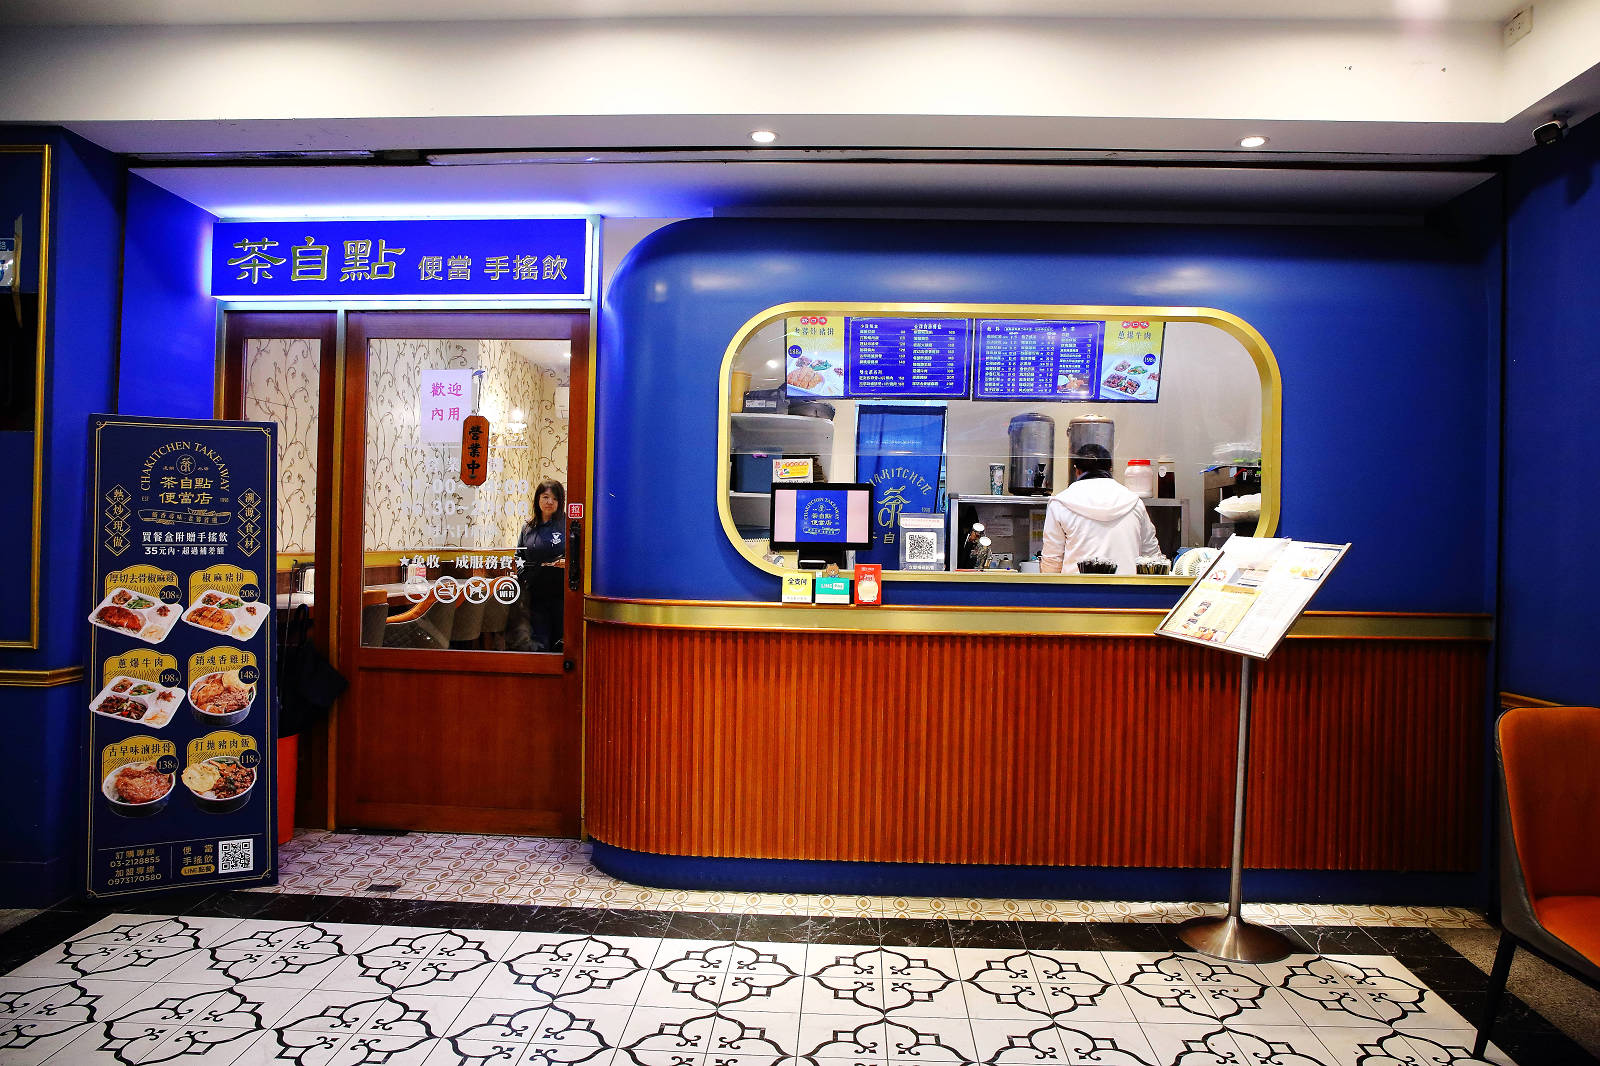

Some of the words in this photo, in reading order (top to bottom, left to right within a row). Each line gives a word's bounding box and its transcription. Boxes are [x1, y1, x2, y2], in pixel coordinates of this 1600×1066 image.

[227, 236, 406, 284] 茶自點
[418, 255, 472, 281] 便當
[483, 254, 568, 281] 手搖飲
[430, 383, 464, 397] 歡迎
[431, 407, 460, 421] 內用
[466, 425, 484, 475] 營業中
[140, 441, 191, 491] CHAKITCHEN
[195, 442, 230, 492] TAKEAWAY
[160, 476, 213, 489] 茶自點
[159, 492, 213, 504] 便當店
[142, 531, 228, 542] 買餐盒附贈手搖飲
[412, 554, 513, 569] 免收一成服務費
[110, 856, 161, 868] 03-2128855
[182, 855, 214, 865] 手搖飲
[107, 873, 162, 886] 0973170580
